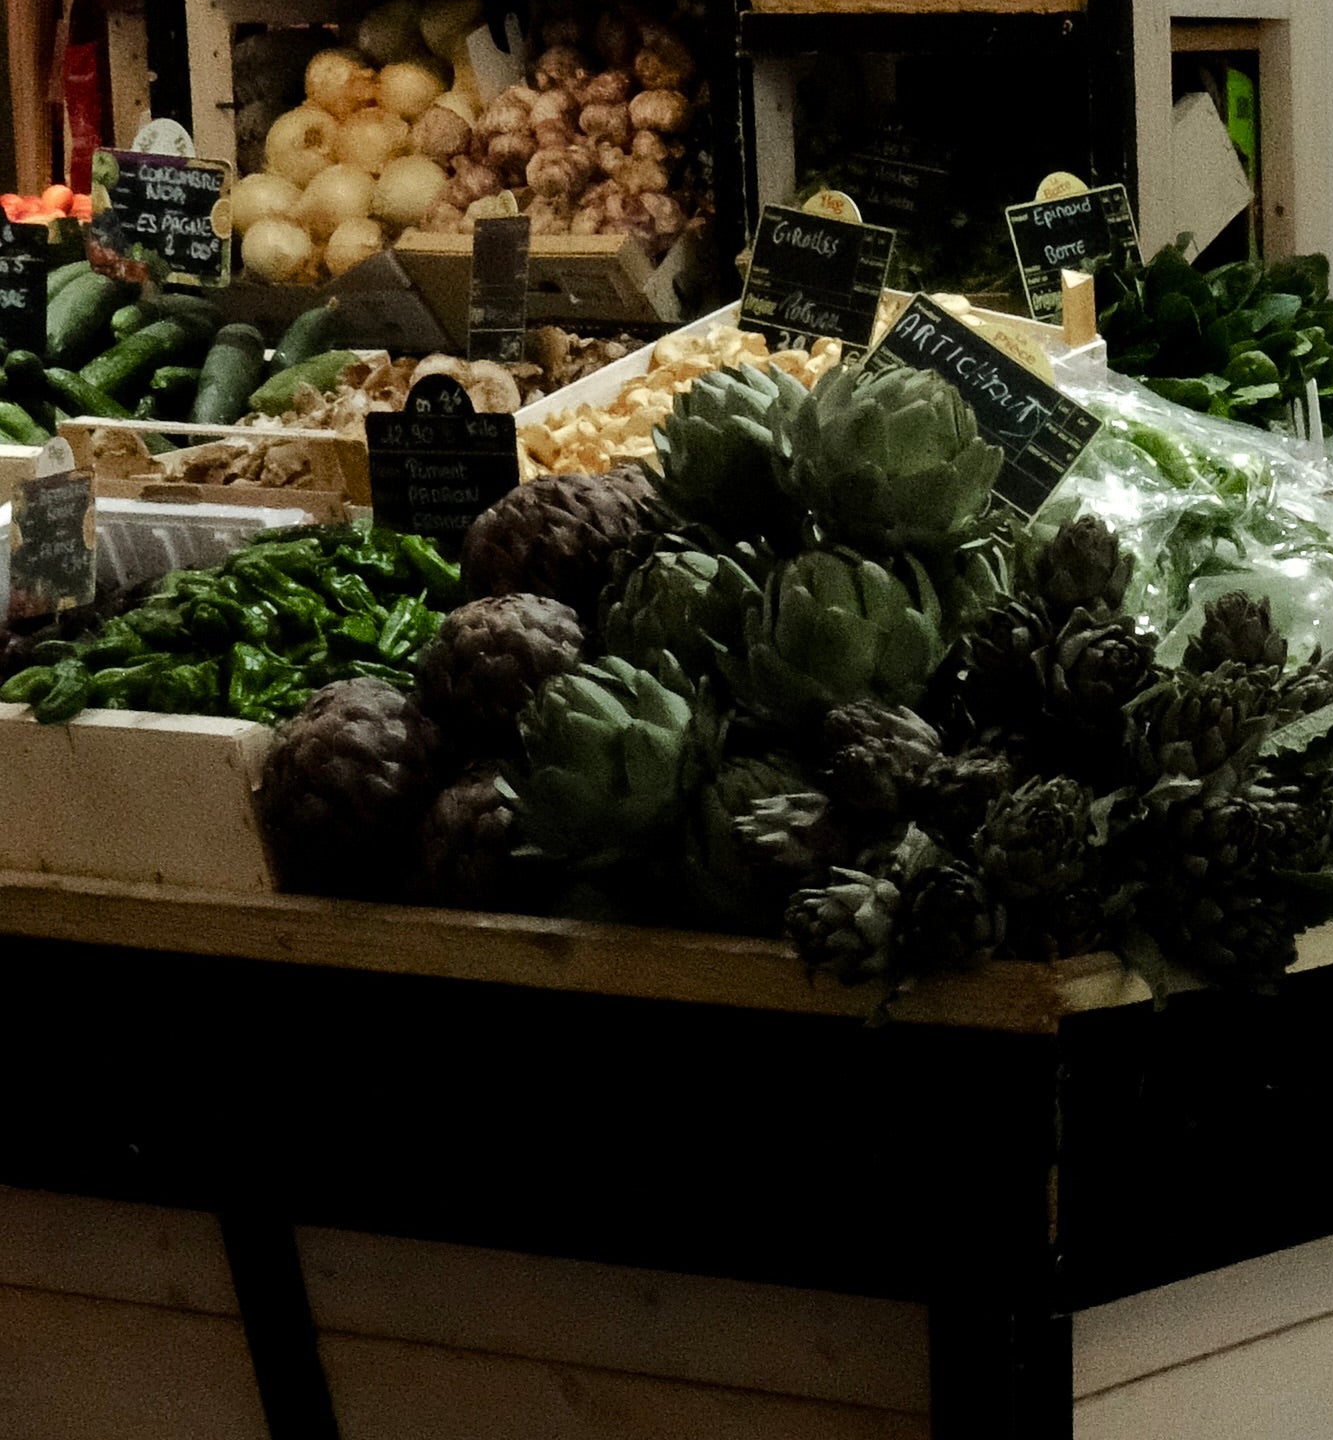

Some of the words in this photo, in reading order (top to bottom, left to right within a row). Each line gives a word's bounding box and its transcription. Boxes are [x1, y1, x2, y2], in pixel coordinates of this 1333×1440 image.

[1033, 196, 1092, 229] Epinard
[1043, 239, 1087, 265] BOTTE
[895, 312, 1052, 424] ARTICHAUT
